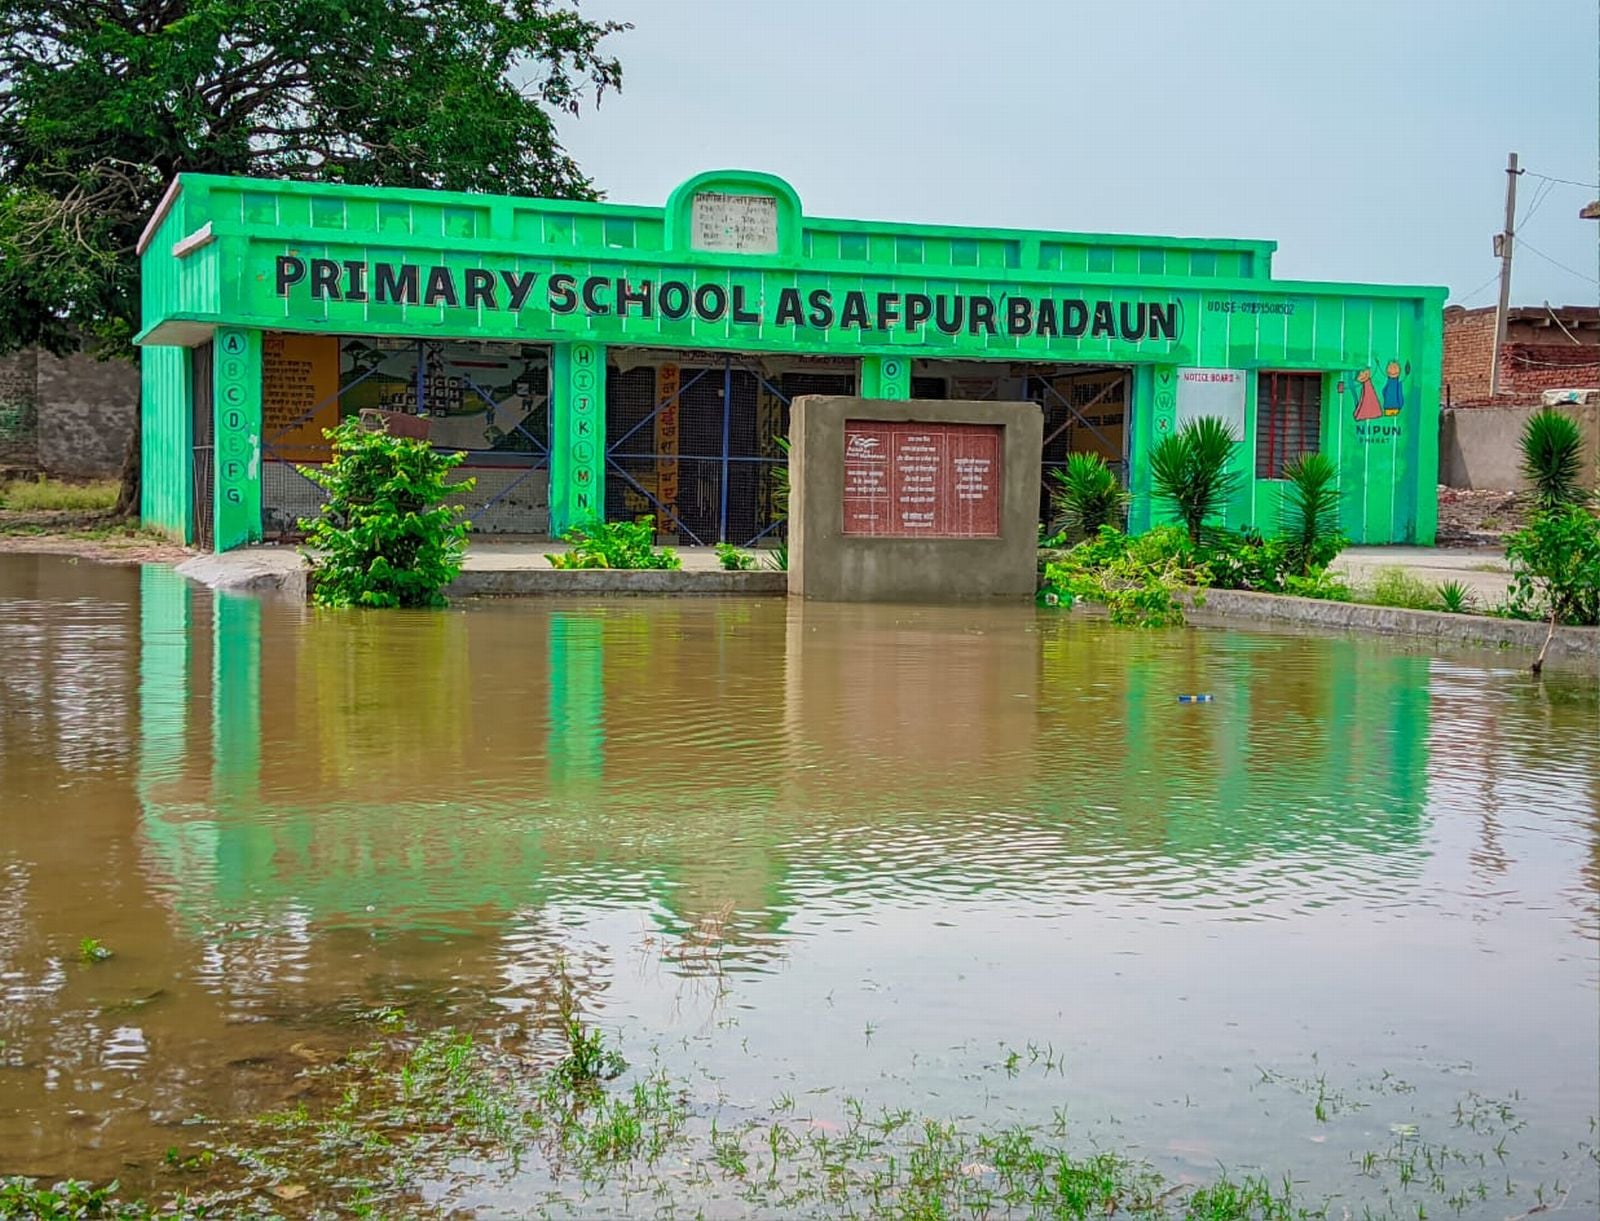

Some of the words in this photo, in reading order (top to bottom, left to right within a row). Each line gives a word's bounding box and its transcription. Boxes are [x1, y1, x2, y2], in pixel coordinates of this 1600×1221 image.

[275, 255, 537, 313] PRIMARY
[547, 272, 760, 325] SCHOOL
[774, 286, 998, 337] ASAFPUR
[227, 336, 238, 350] A
[1184, 372, 1208, 382] NOTICE
[229, 413, 239, 426] D
[1356, 425, 1401, 436] NIPUN
[227, 489, 240, 503] G
[577, 494, 588, 509] N
